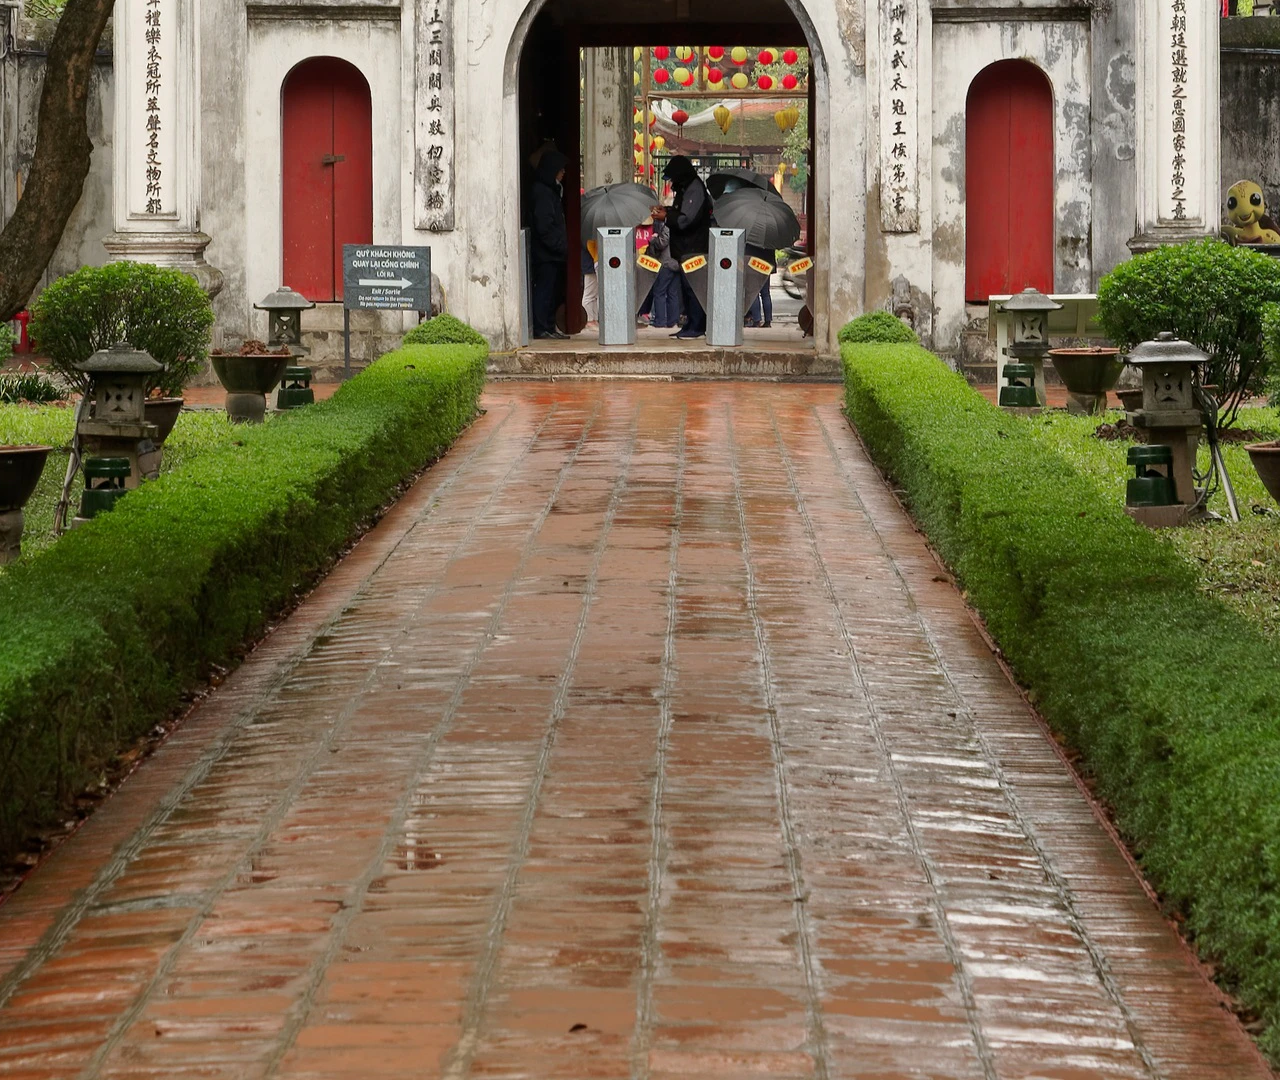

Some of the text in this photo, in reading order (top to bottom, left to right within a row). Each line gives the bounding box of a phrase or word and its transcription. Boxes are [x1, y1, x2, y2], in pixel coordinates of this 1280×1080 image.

[371, 250, 392, 258] KHÁCH
[393, 250, 416, 259] KHÔNG
[352, 260, 370, 268] QUAY
[370, 261, 381, 269] LẠI
[640, 257, 659, 269] STOP
[684, 257, 703, 270] STOP
[751, 259, 770, 272] STOP
[791, 260, 809, 273] STOP
